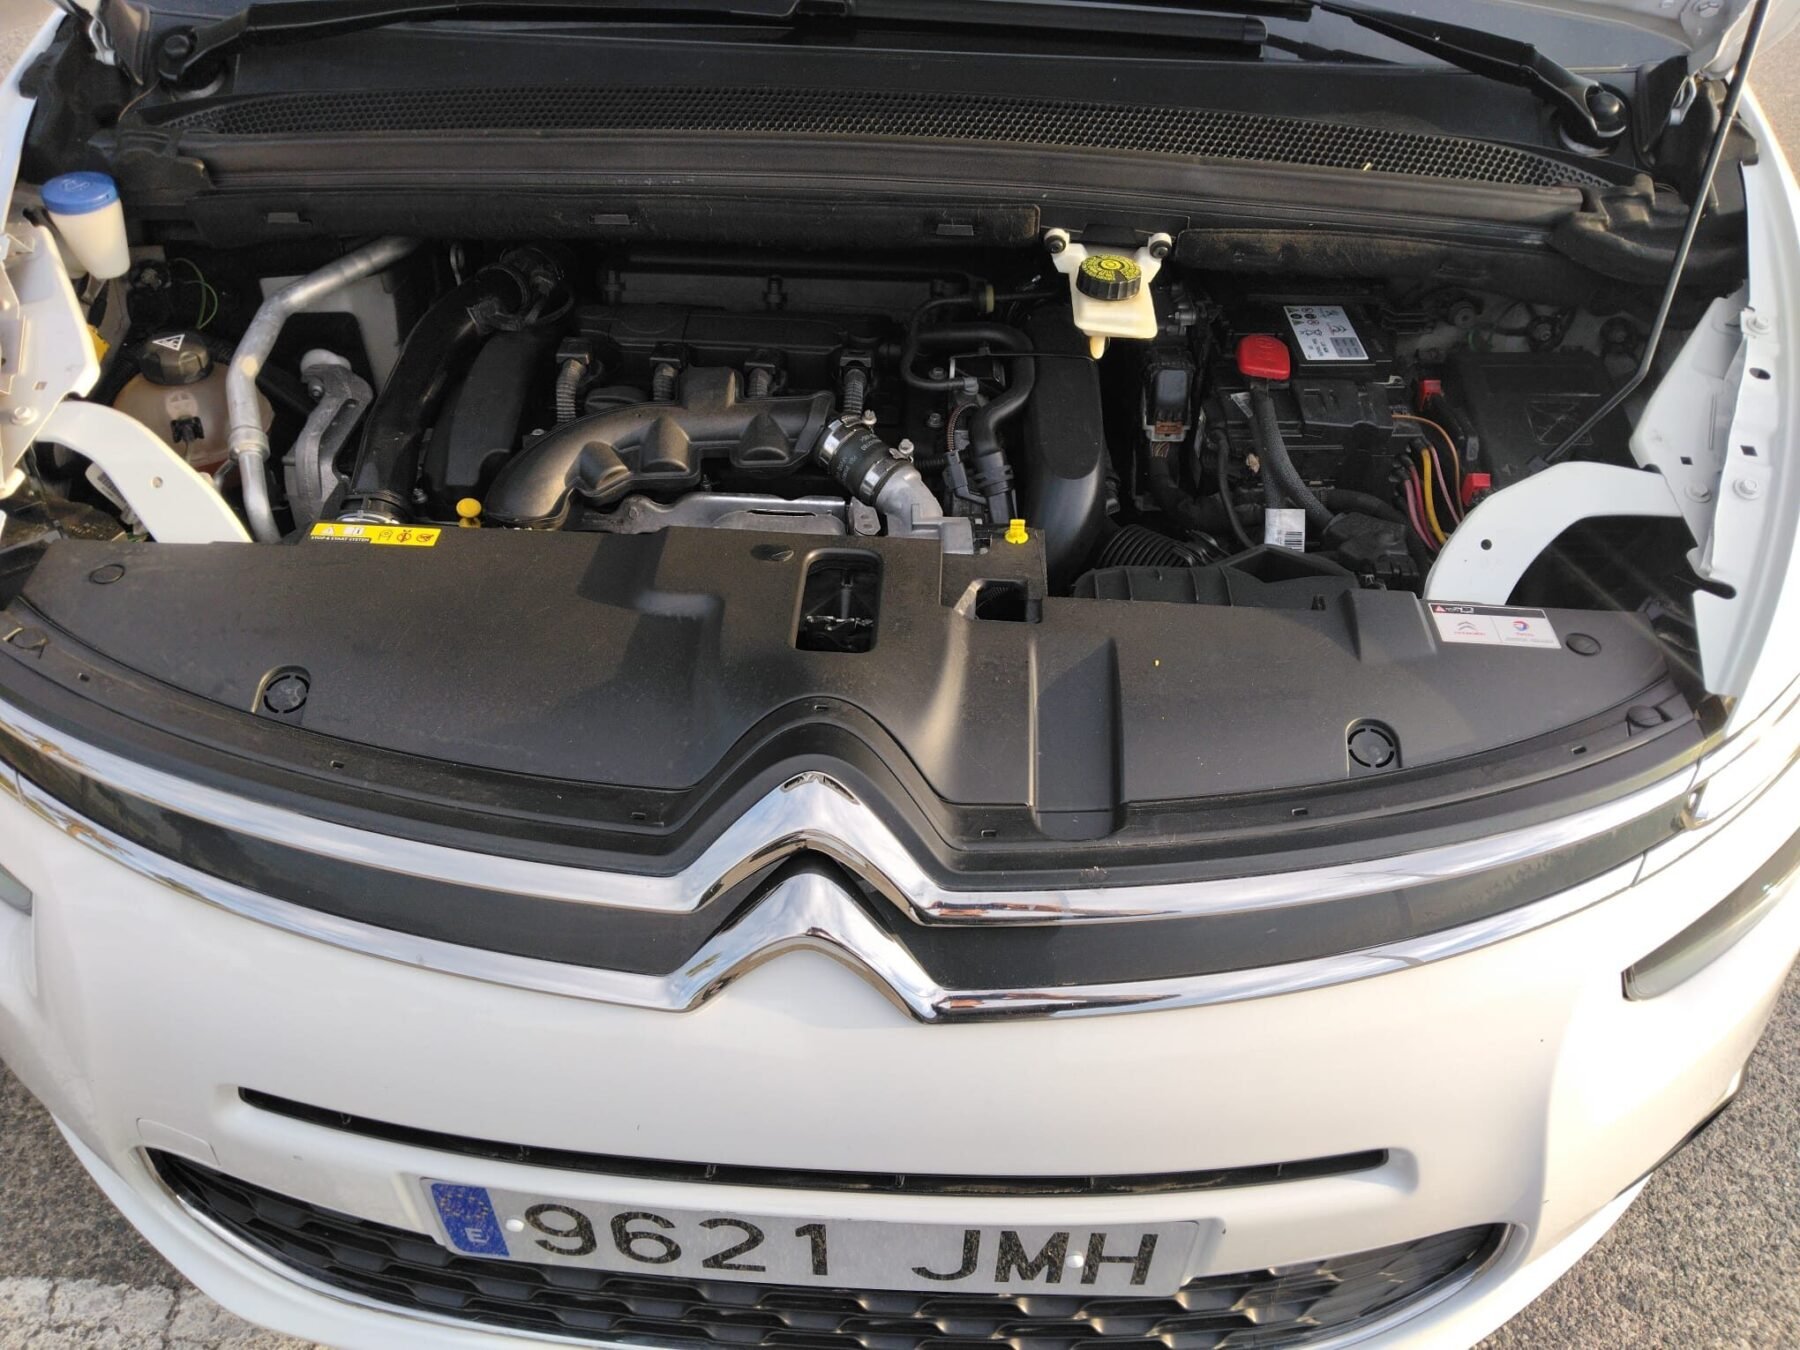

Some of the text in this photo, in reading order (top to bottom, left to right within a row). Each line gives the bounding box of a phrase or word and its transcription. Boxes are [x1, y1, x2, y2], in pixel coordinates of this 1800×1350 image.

[465, 1227, 490, 1244] E
[525, 1203, 1158, 1285] 9621 JMH
